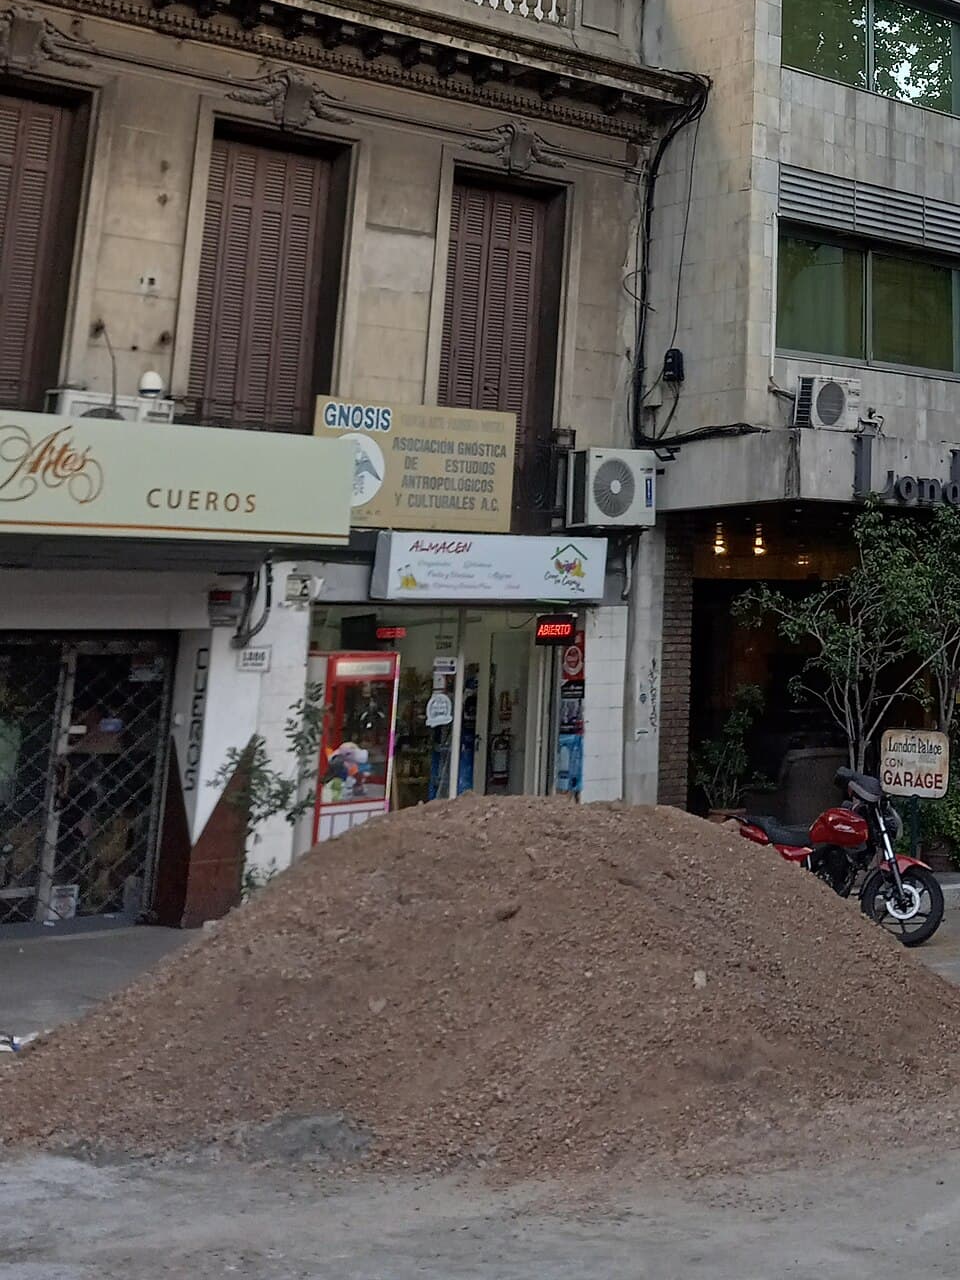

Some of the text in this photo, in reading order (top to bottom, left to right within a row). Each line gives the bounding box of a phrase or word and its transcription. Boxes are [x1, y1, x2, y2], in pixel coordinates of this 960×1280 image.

[323, 402, 392, 431] GNOSIS
[404, 456, 496, 476] DE ESTUDIOS
[146, 488, 257, 513] CUEROS
[394, 493, 401, 507] Y
[407, 494, 475, 510] CULTURALES
[409, 540, 473, 555] ALMACEN
[537, 624, 572, 636] ABIERTO
[888, 735, 943, 755] London Palace
[884, 758, 903, 768] CON
[883, 770, 943, 790] GARAGE
